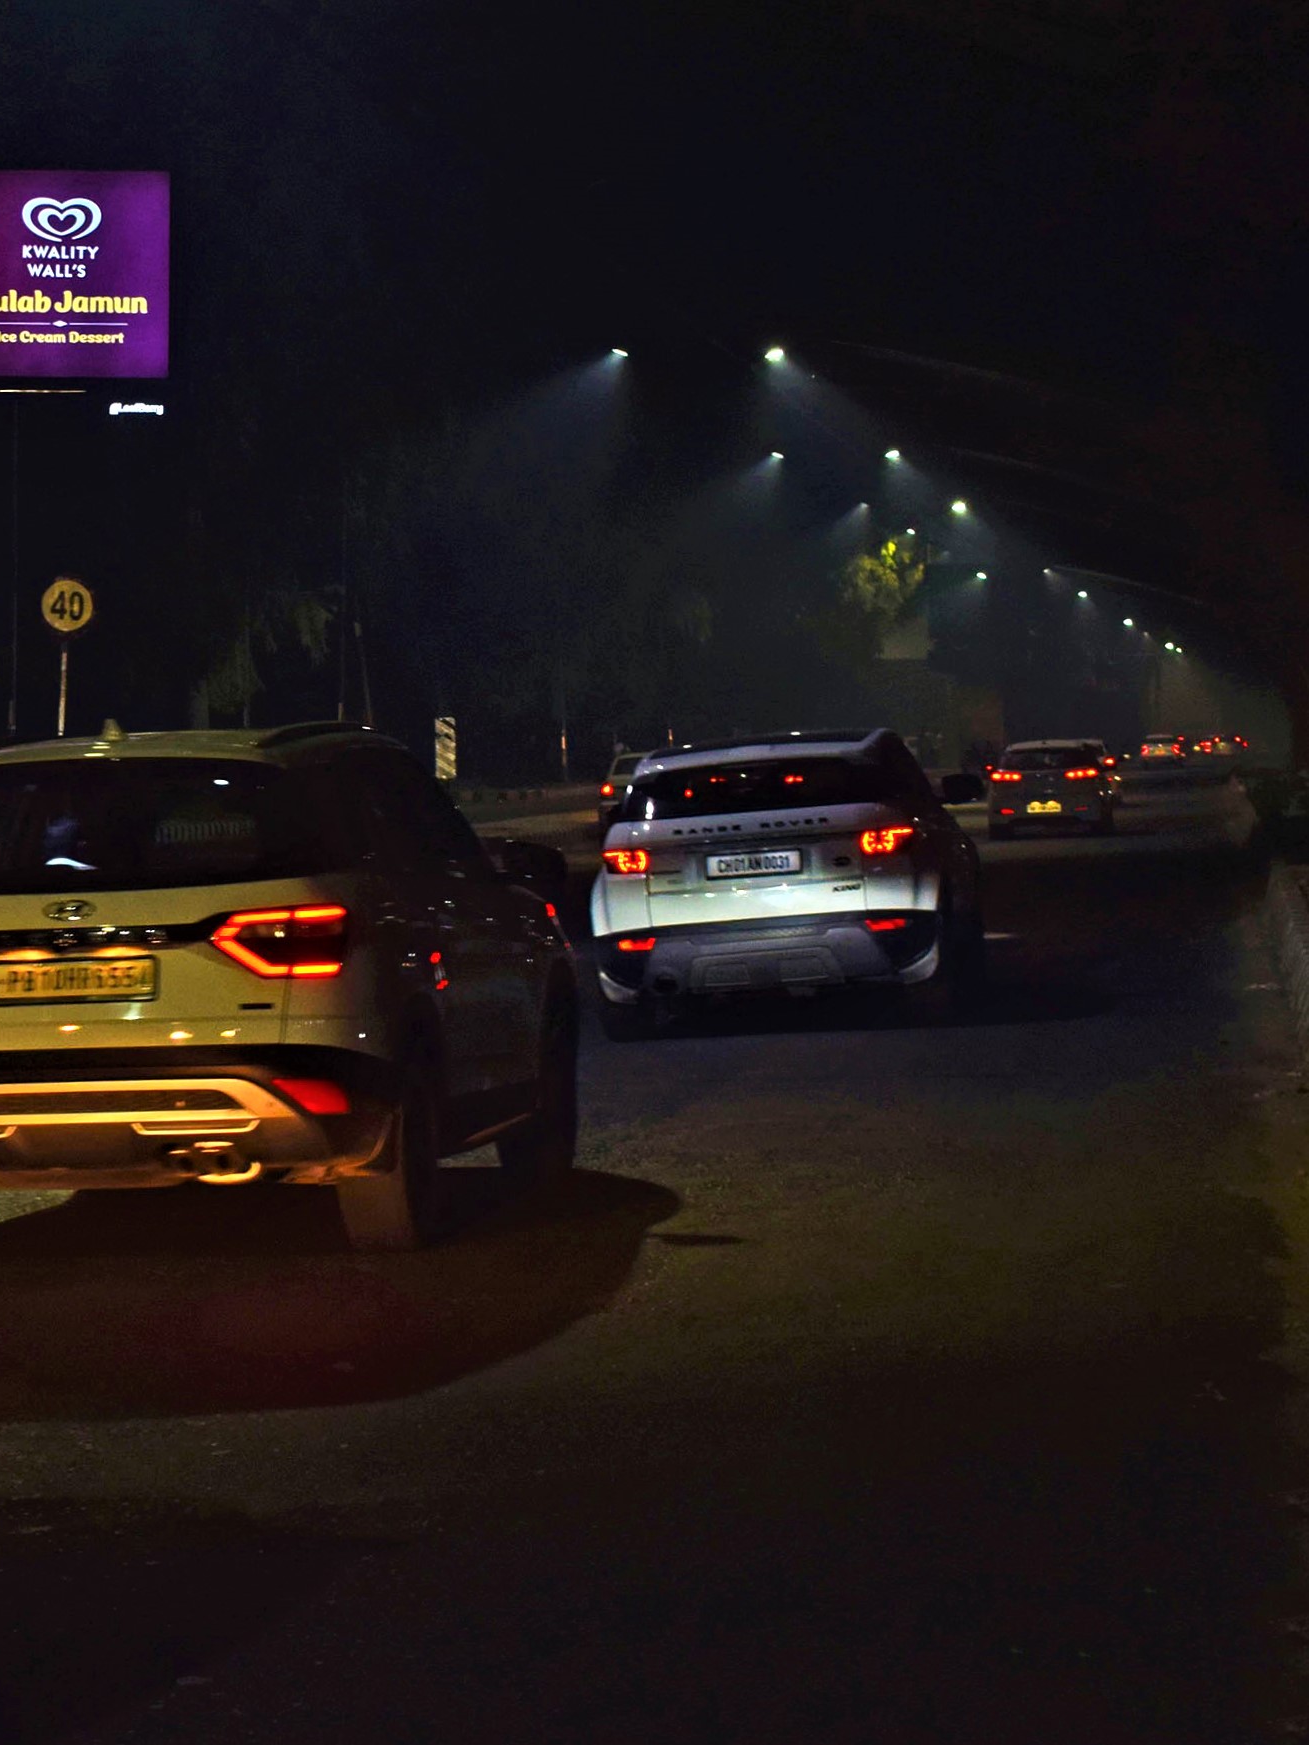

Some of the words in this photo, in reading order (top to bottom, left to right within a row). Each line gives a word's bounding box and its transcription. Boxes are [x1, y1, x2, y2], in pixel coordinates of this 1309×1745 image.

[22, 245, 99, 260] KWALITY
[27, 264, 87, 278] WALL'S
[54, 290, 148, 315] Jamun
[19, 331, 66, 344] Cream
[69, 331, 125, 344] Dessert
[50, 590, 84, 621] 40
